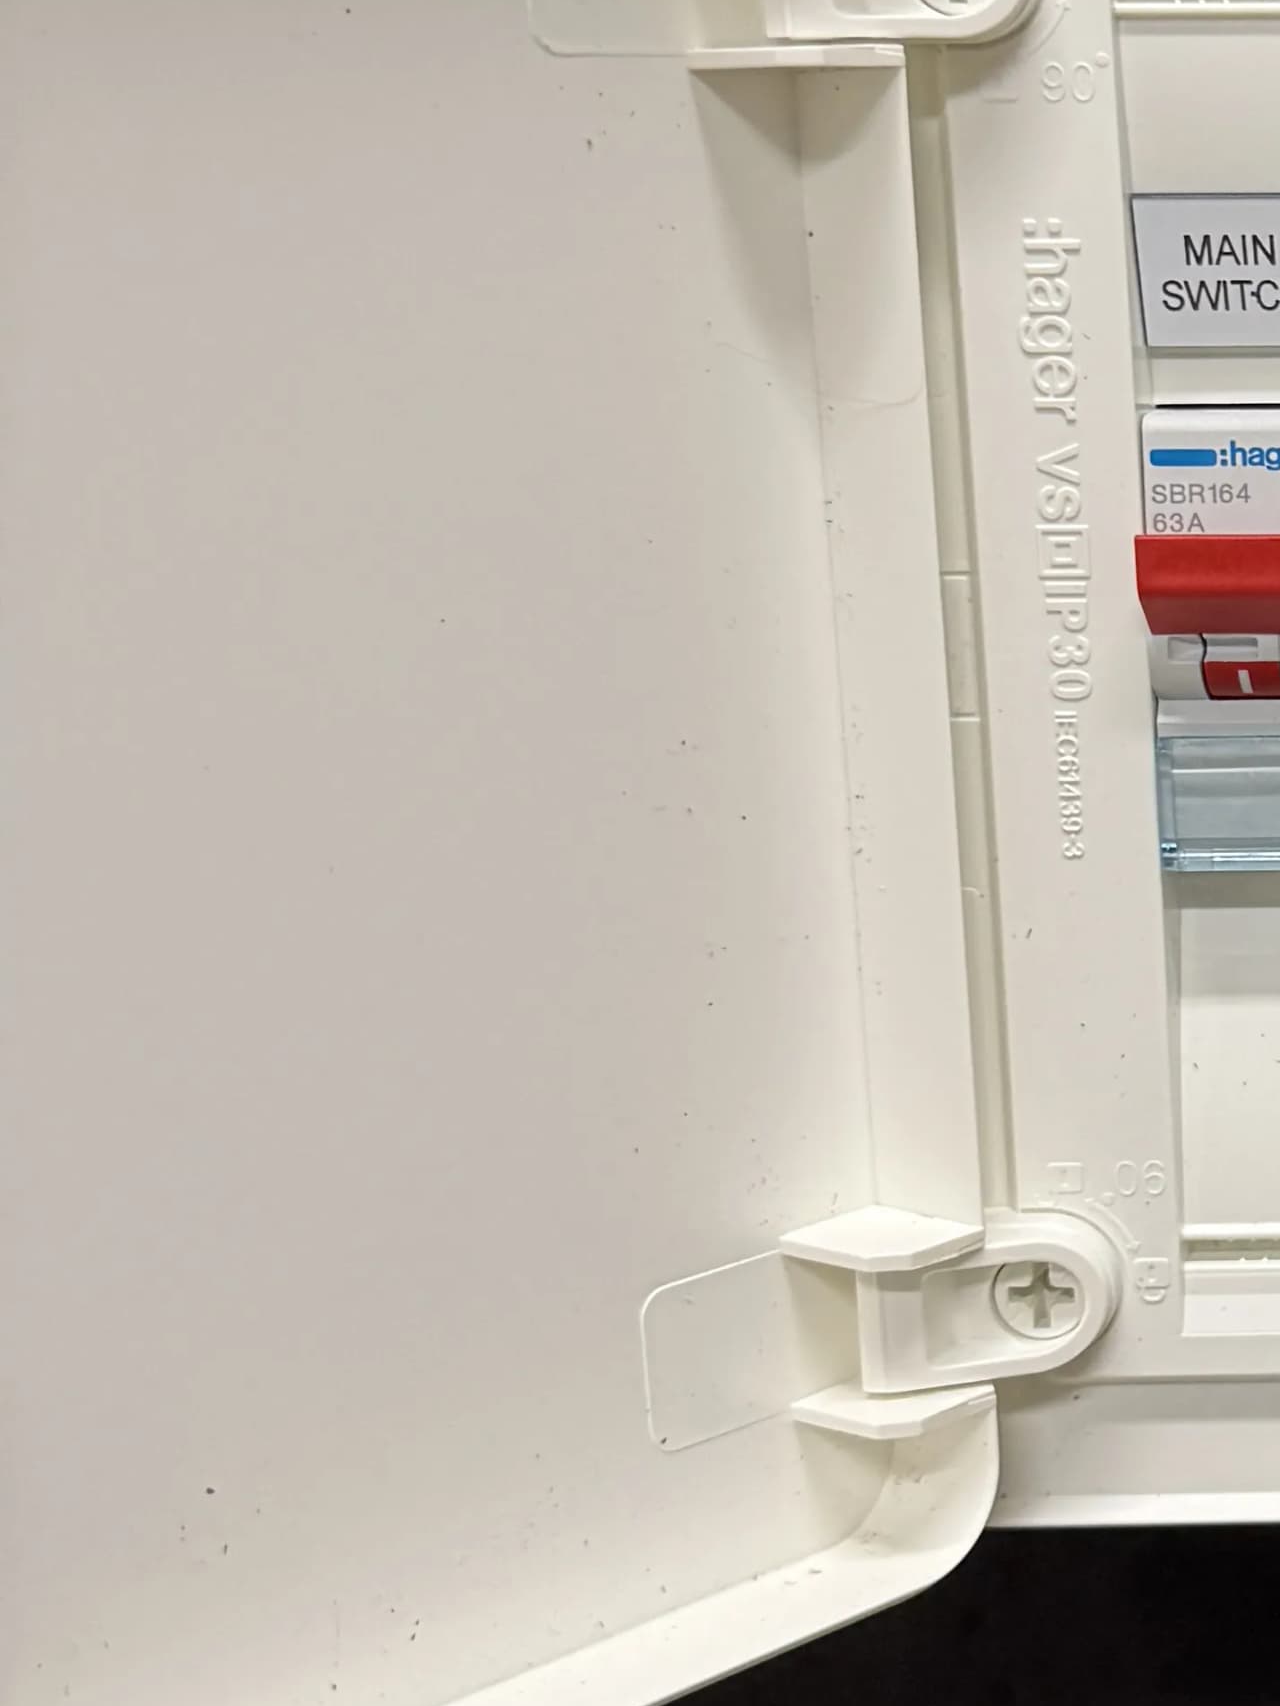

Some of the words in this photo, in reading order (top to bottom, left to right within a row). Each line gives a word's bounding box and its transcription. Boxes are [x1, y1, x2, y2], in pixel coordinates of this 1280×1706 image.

[1183, 234, 1277, 266] MAIN
[1151, 483, 1251, 505] SBR164
[1153, 512, 1205, 533] 63A
